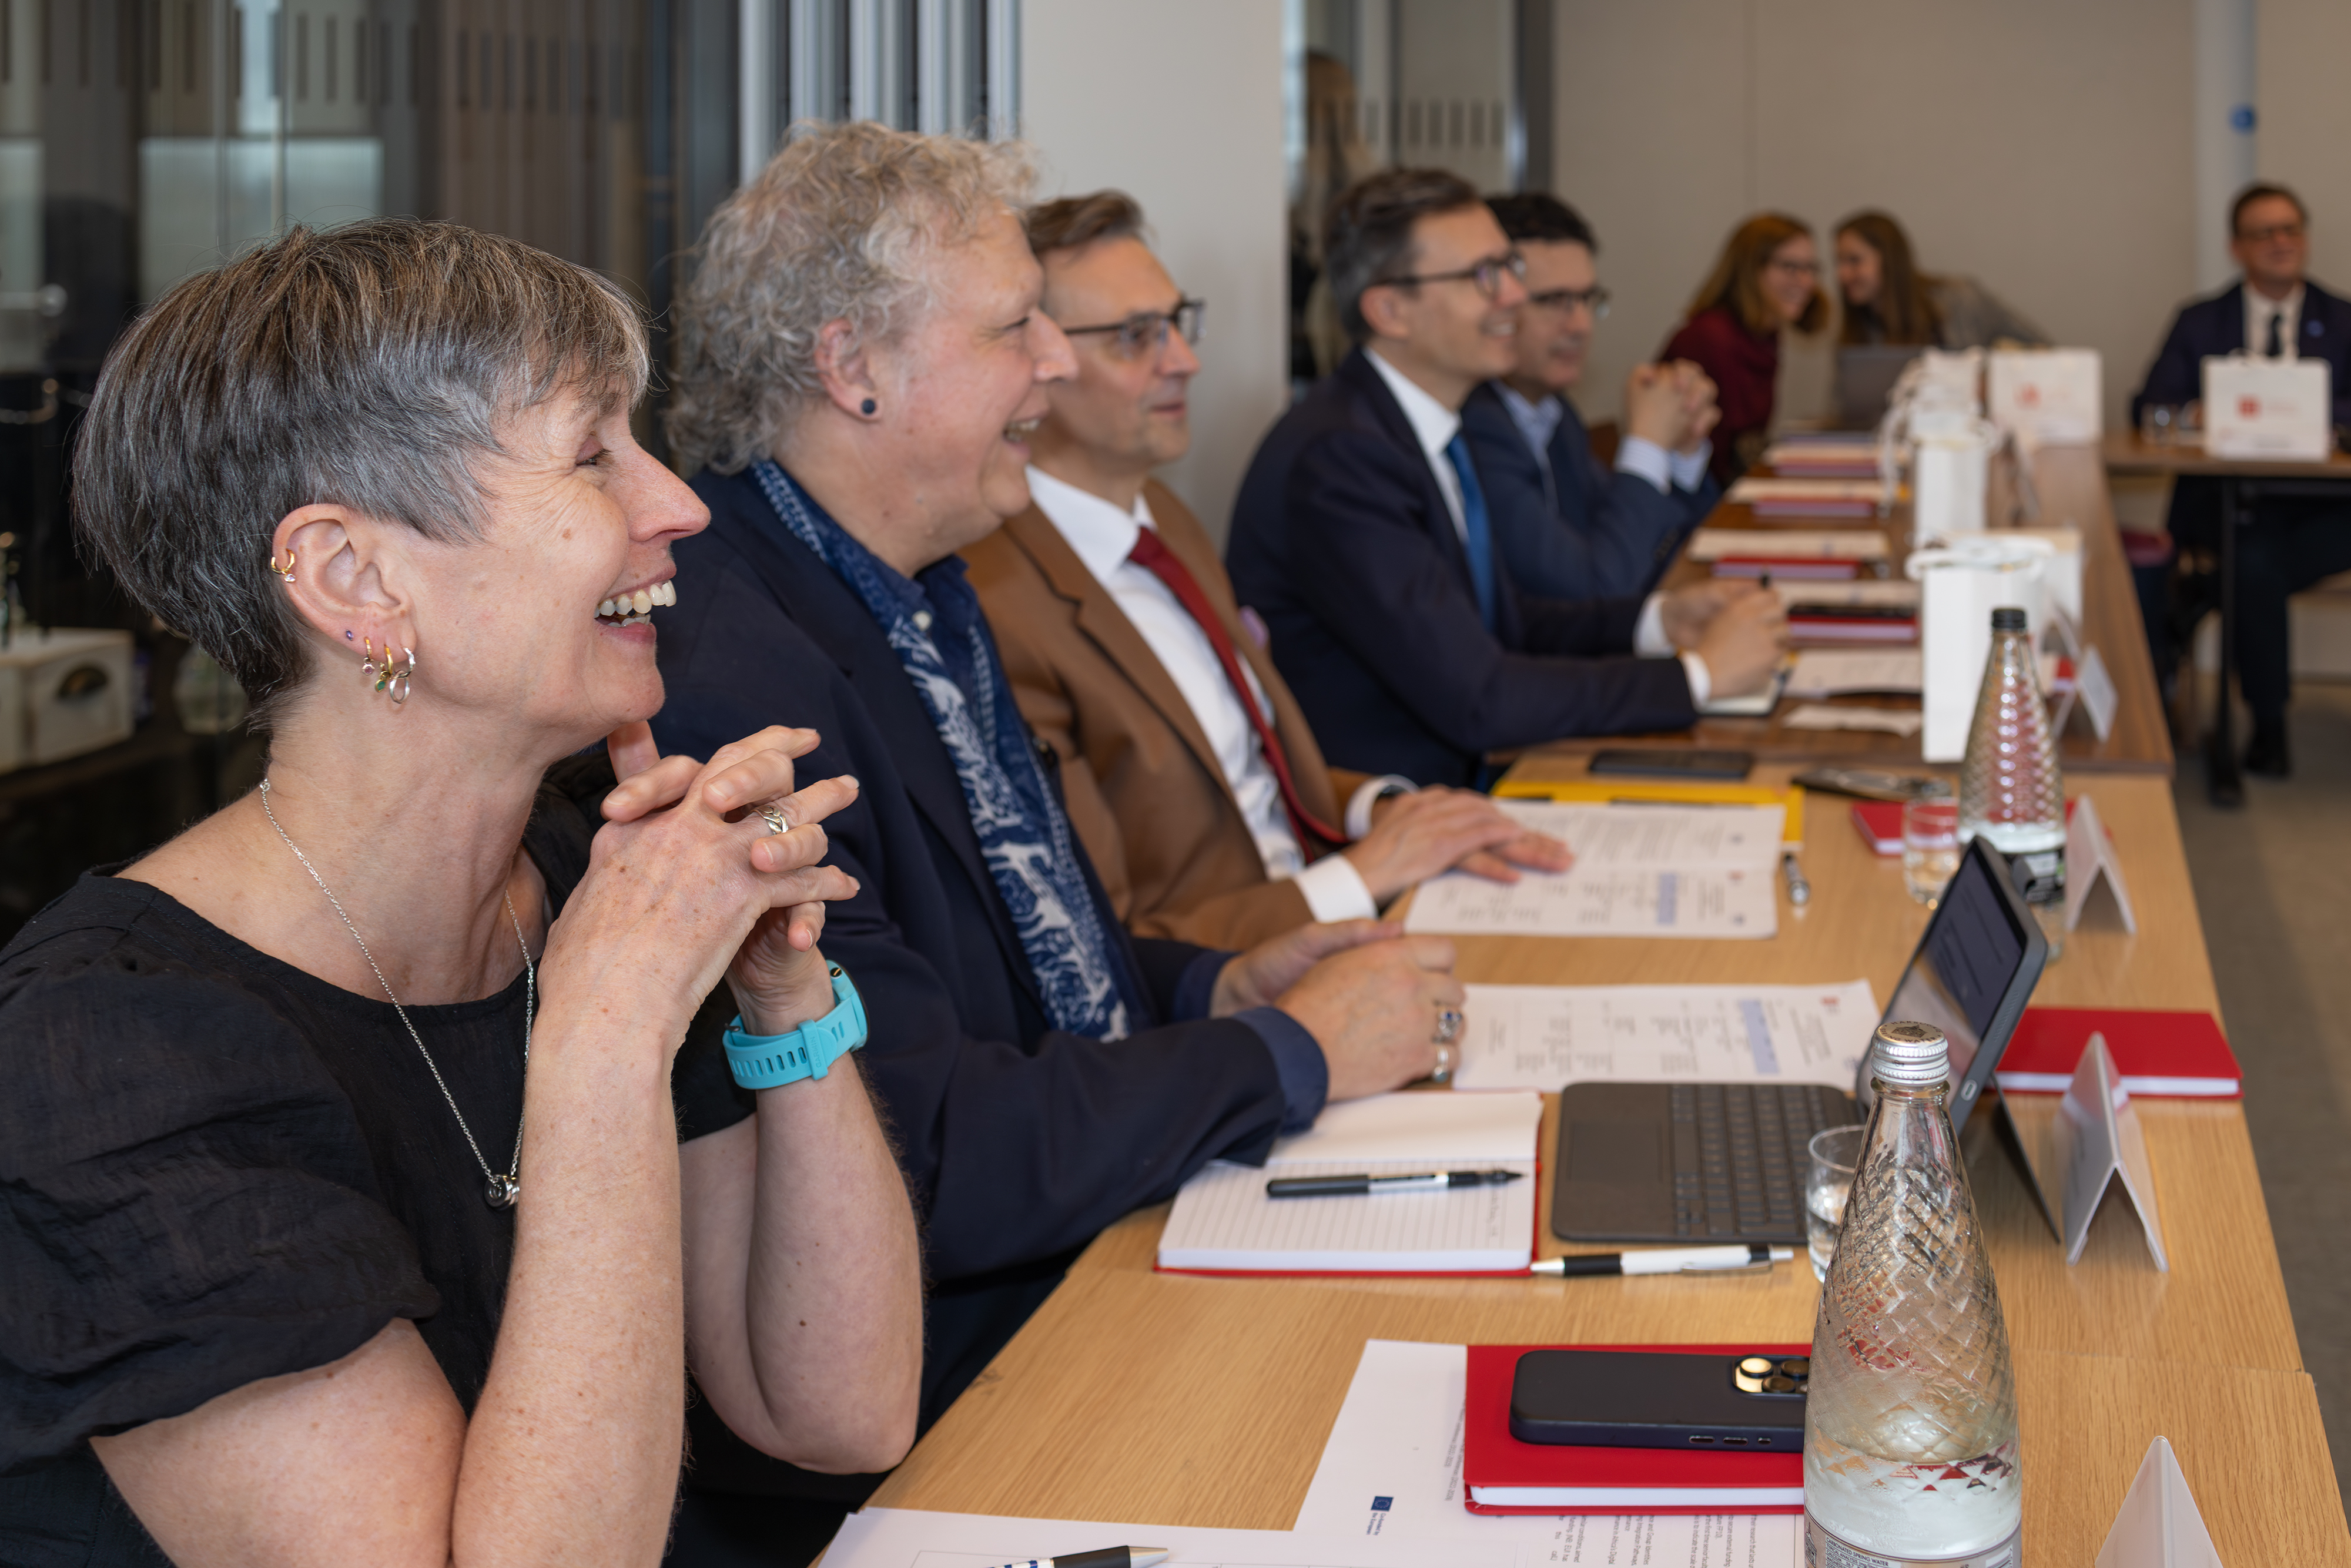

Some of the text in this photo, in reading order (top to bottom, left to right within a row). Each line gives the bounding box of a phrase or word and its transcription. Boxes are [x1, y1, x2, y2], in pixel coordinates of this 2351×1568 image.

[810, 1036, 822, 1068] GARMIN
[1366, 1519, 1377, 1536] European
[1635, 1523, 1643, 1544] Integration
[1645, 1532, 1654, 1545] Group
[1724, 1552, 1732, 1567] funding
[1826, 1537, 1888, 1567] CARBONATED SPRING WATER
[1826, 1543, 1839, 1556] TYPICAL
[1840, 1553, 1858, 1564] ANALYSIS
[1826, 1550, 1842, 1562] CALCIUM
